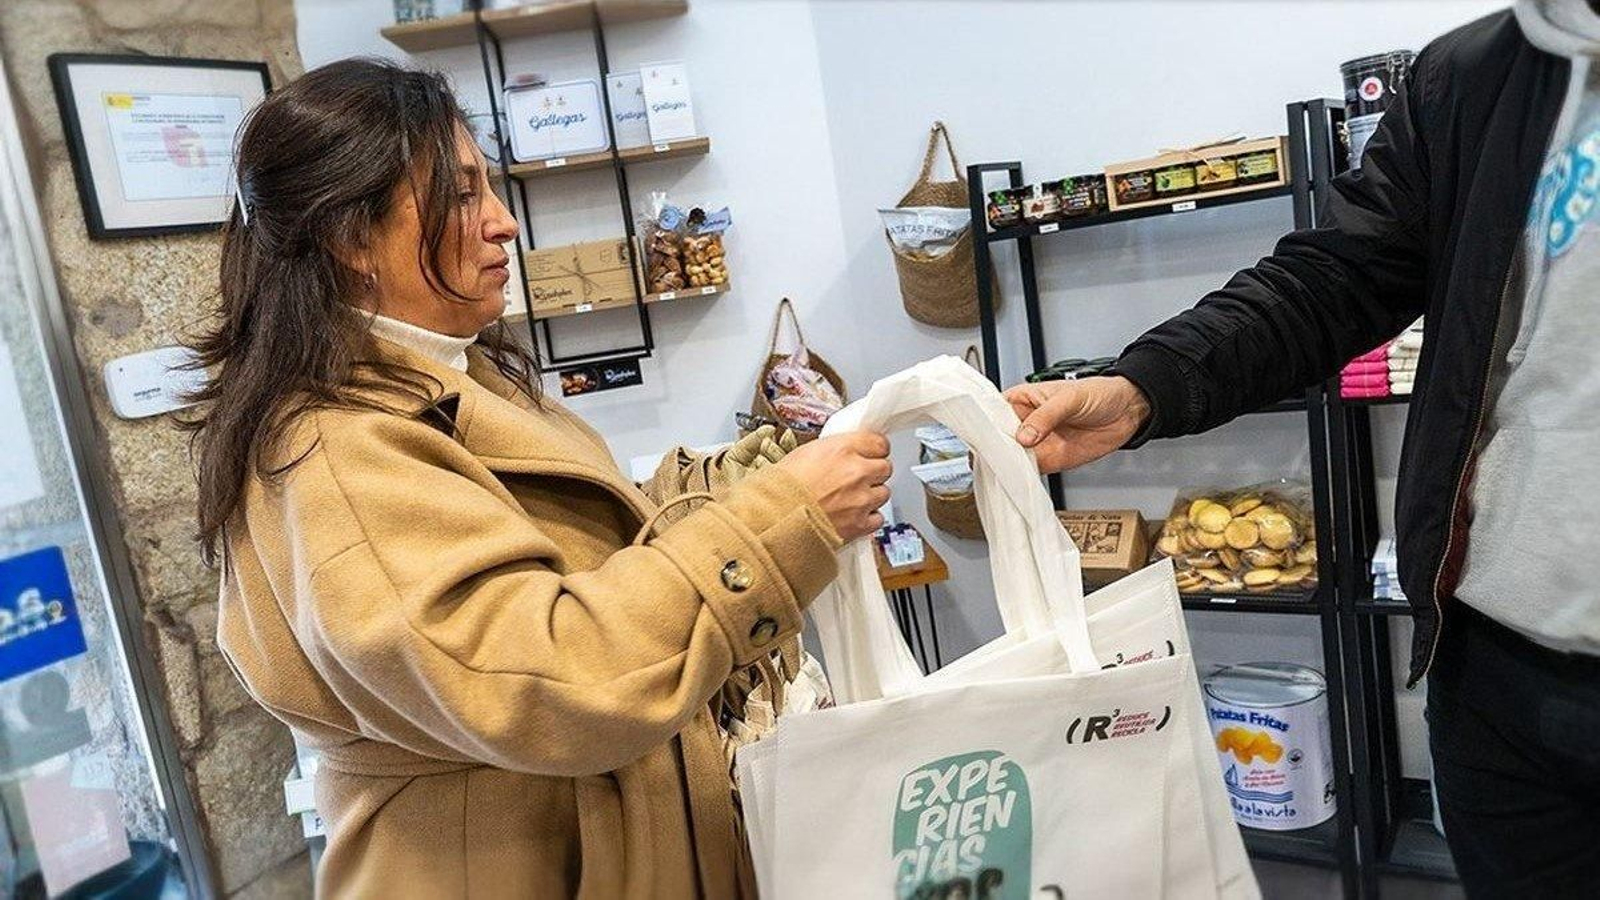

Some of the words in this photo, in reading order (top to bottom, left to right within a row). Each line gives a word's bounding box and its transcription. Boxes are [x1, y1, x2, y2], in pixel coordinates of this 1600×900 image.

[529, 112, 587, 131] Gallegas
[1249, 712, 1290, 732] Fritas
[900, 755, 1011, 812] EXPE
[916, 790, 1017, 845] RIEN
